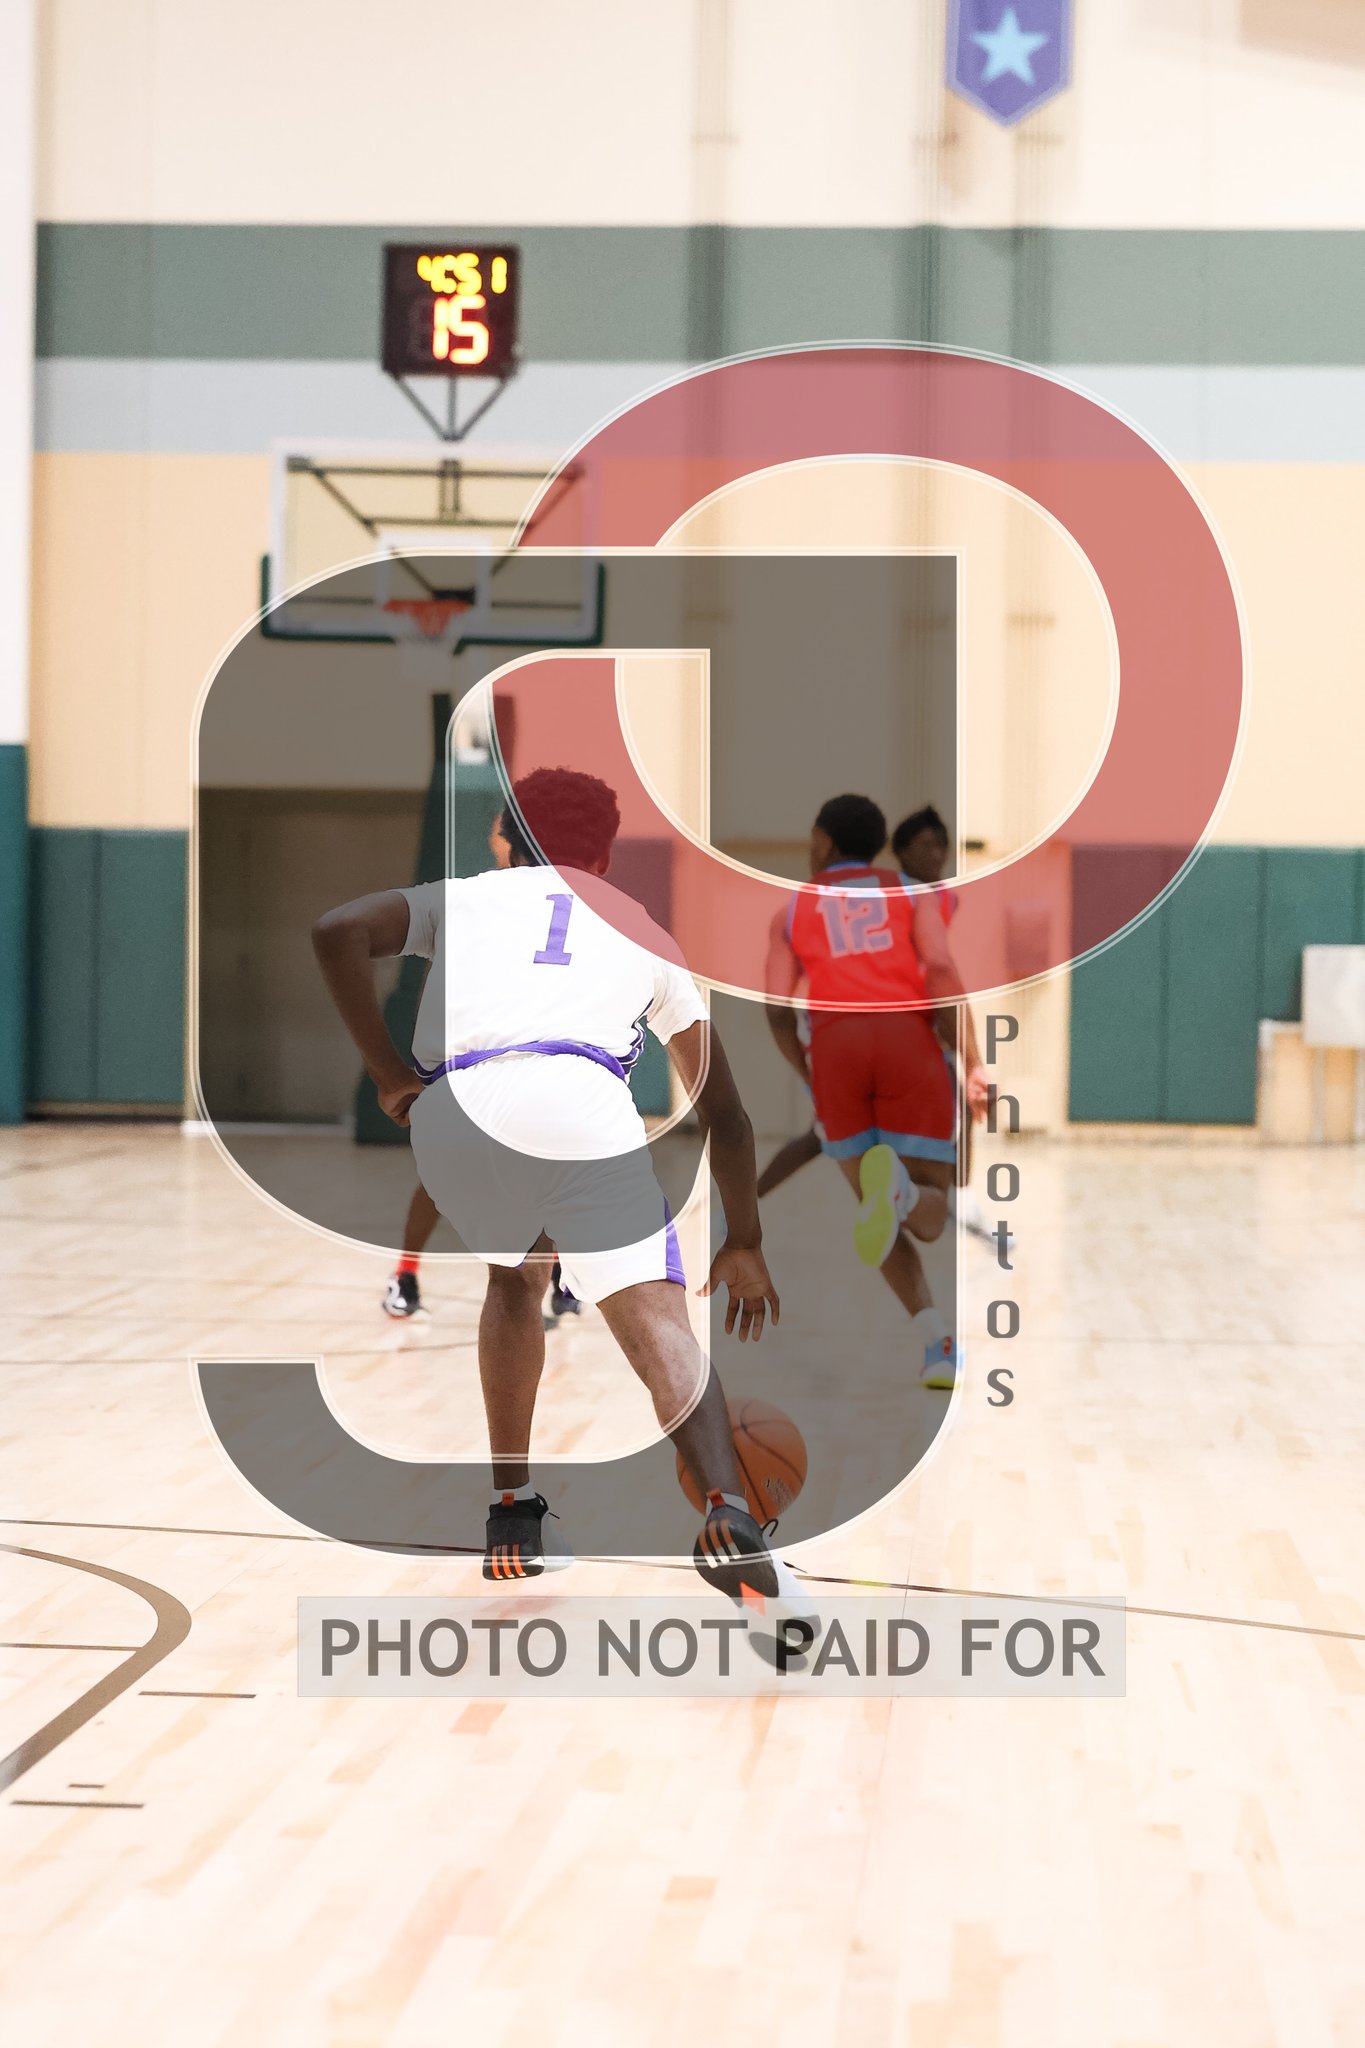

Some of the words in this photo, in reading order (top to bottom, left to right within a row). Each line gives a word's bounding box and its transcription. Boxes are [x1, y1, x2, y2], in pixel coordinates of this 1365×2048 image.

[433, 294, 489, 364] 15
[533, 893, 574, 966] 1
[815, 889, 894, 959] 12
